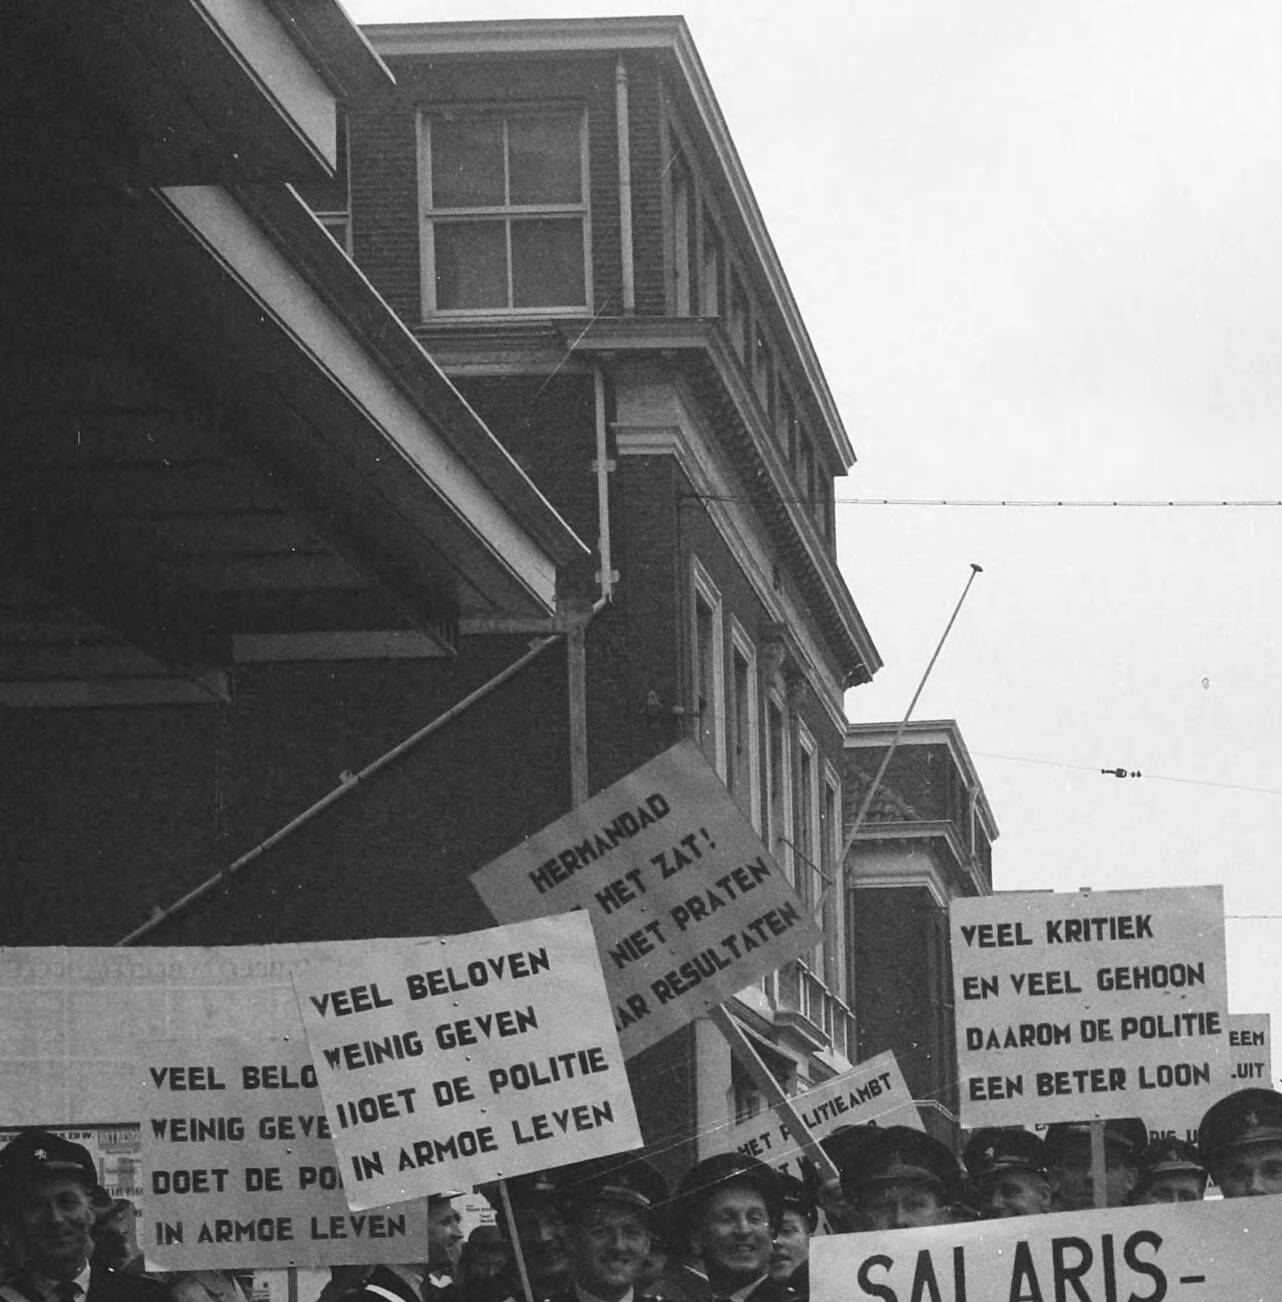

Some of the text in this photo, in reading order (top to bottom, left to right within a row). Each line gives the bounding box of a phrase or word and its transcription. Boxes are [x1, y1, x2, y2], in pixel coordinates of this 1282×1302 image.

[529, 793, 670, 894] HERMANDAD
[594, 827, 716, 914] HET ZAT!
[609, 856, 771, 969] NIET PRATEN
[961, 915, 1153, 947] VEEL KRITIEK
[651, 902, 802, 1004] RESULTATEN
[310, 948, 550, 1018] VEEL BELOVEN
[963, 962, 1204, 999] EN VEEL GEHOON
[323, 1006, 538, 1070] WEINIG GEVEN
[966, 1012, 1222, 1050] DAAROM DE POLITIE
[1229, 1031, 1264, 1046] EEM
[150, 1065, 318, 1090] VEEL BELO
[433, 1077, 475, 1107] DE
[489, 1048, 609, 1094] POLITIE
[969, 1063, 1209, 1100] EEN BETER LOON
[1232, 1063, 1264, 1078] UIT
[780, 1072, 892, 1141] PLITIEAMBT
[151, 1118, 244, 1142] WEINIG
[259, 1116, 332, 1139] GEVE
[352, 1152, 384, 1181] IN
[400, 1127, 498, 1171] ARMOE
[512, 1101, 614, 1144] LEVEN
[153, 1169, 228, 1194] DOET
[246, 1167, 282, 1191] DE
[156, 1215, 405, 1245] IN ARMOE LEVEN
